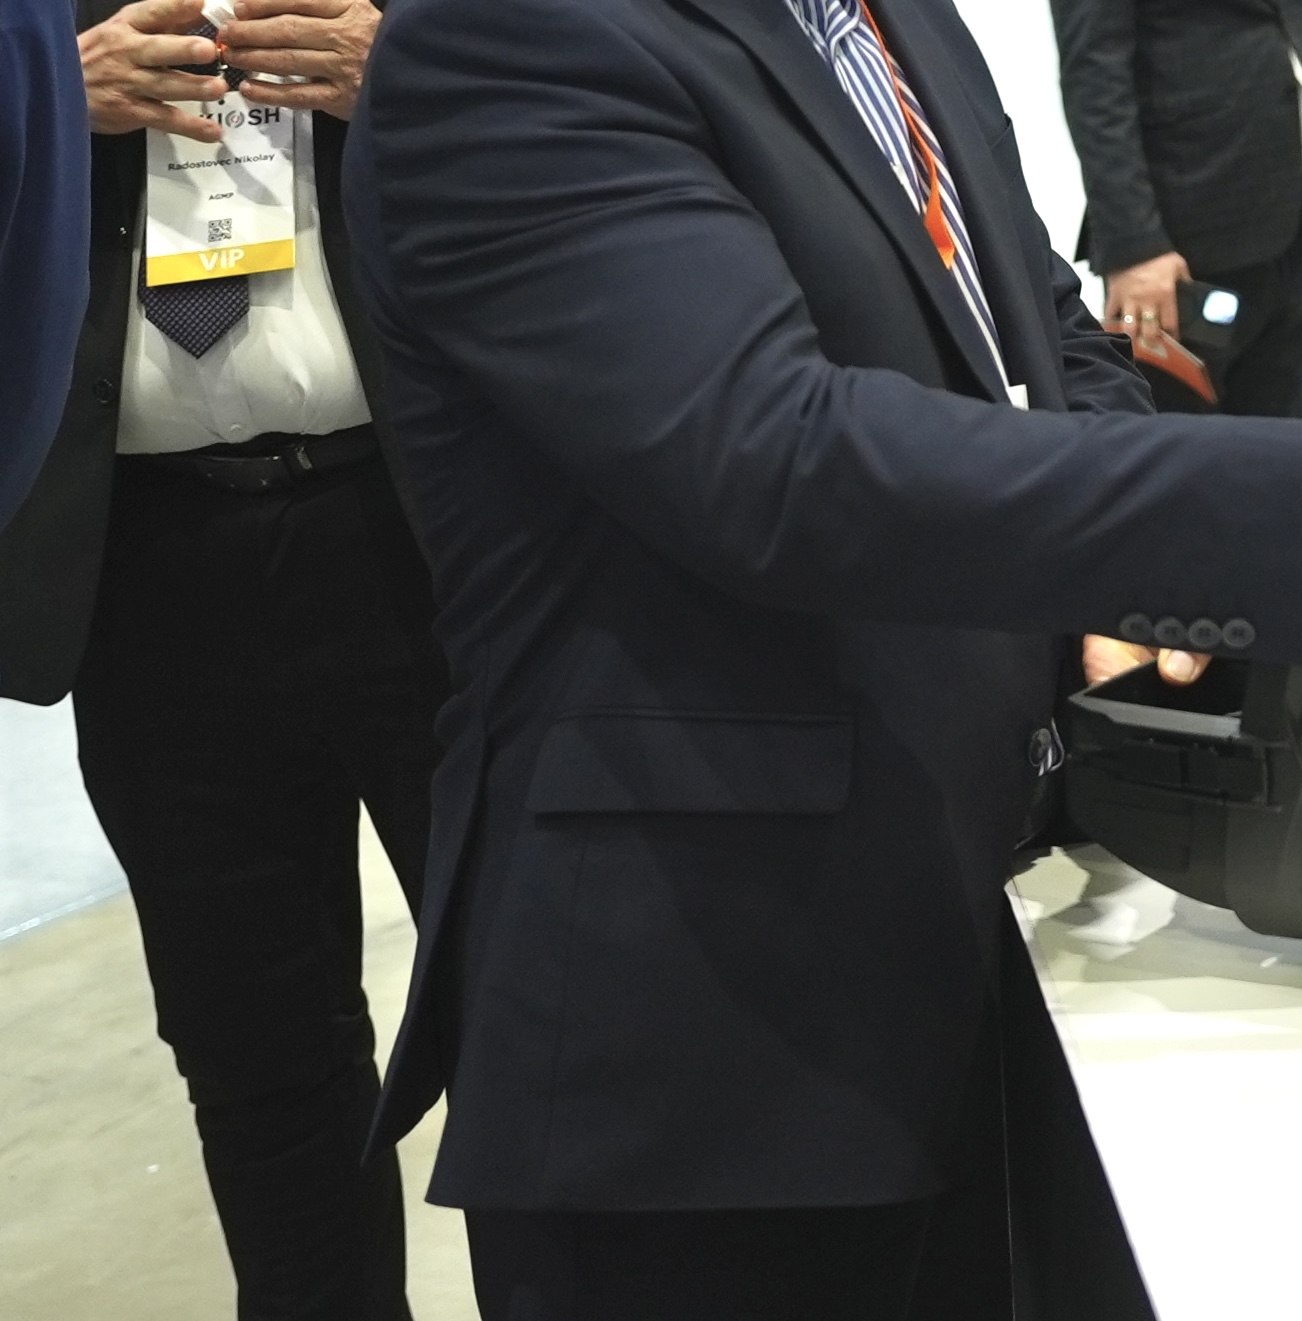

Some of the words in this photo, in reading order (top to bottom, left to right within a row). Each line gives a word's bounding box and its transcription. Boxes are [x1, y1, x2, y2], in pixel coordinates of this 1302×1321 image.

[168, 157, 231, 171] Radostovec
[234, 153, 275, 165] Nikolay
[200, 248, 244, 271] VIP
